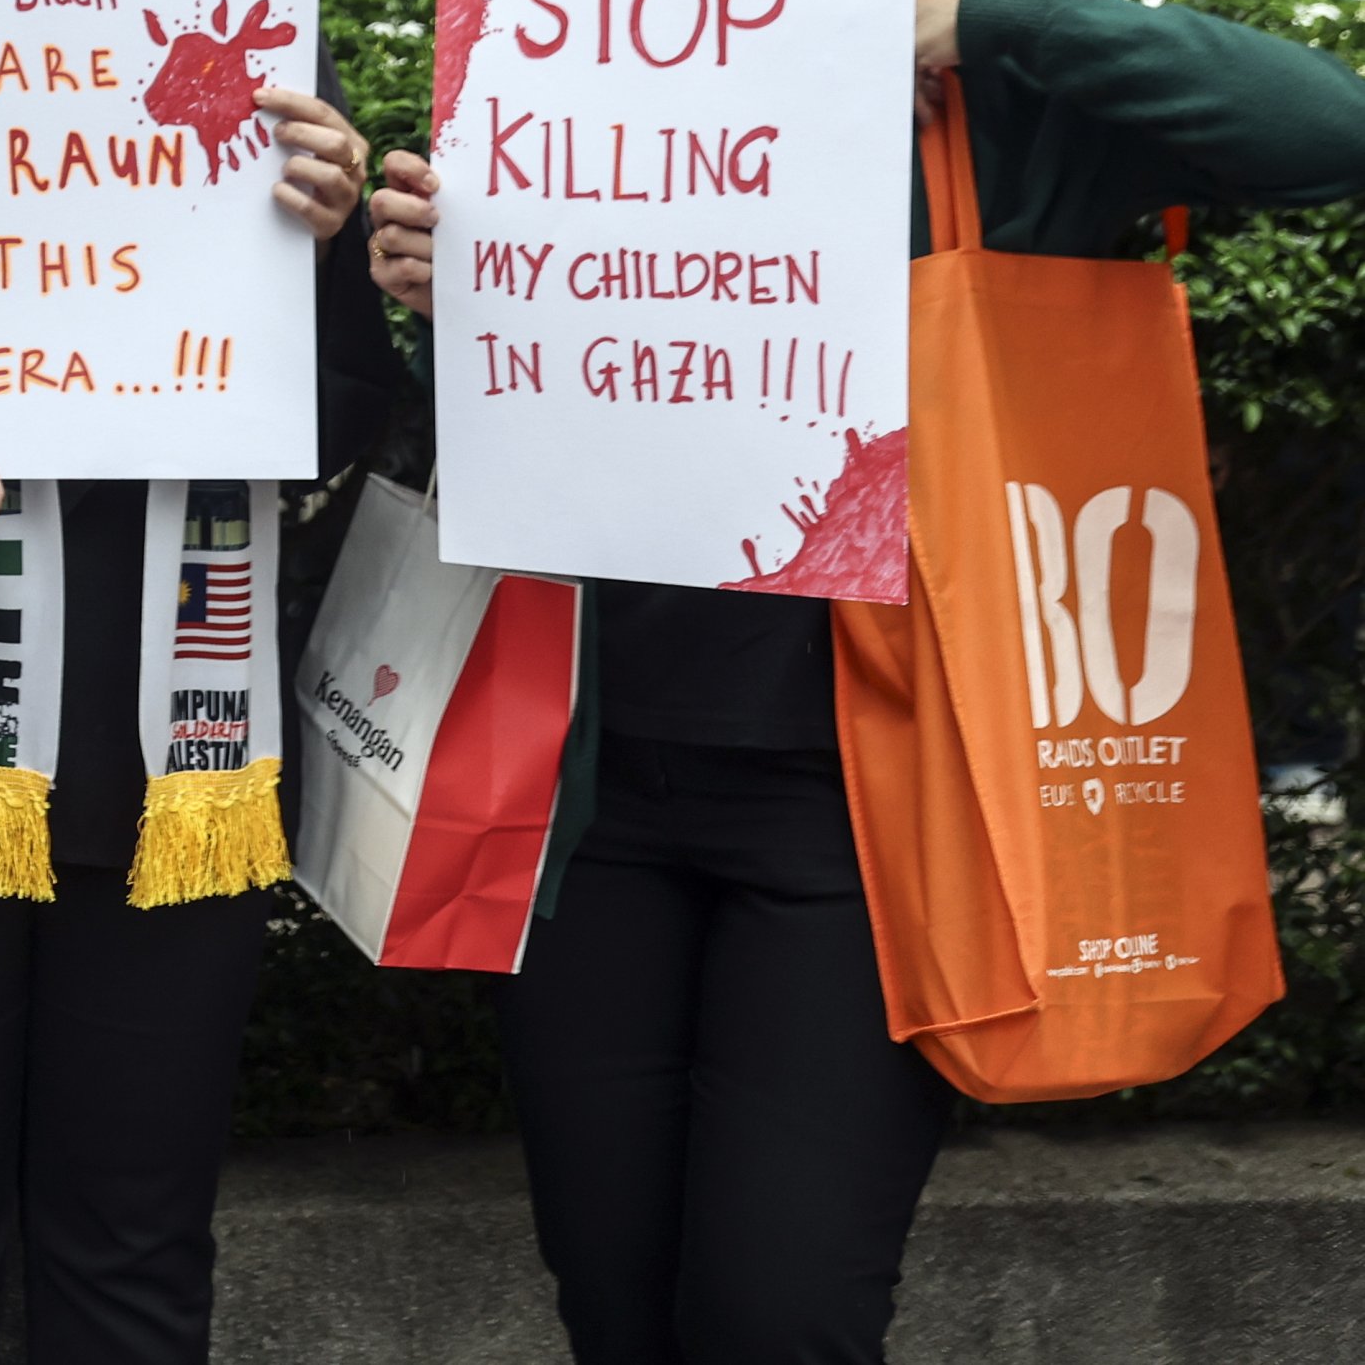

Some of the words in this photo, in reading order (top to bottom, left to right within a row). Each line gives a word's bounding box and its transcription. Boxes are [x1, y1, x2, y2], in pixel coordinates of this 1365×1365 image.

[486, 98, 778, 203] KILLING
[473, 239, 555, 301] MY
[568, 247, 820, 305] CHILDREN
[477, 332, 542, 397] IN
[1005, 481, 1200, 728] BO
[314, 669, 405, 772] Kenangan
